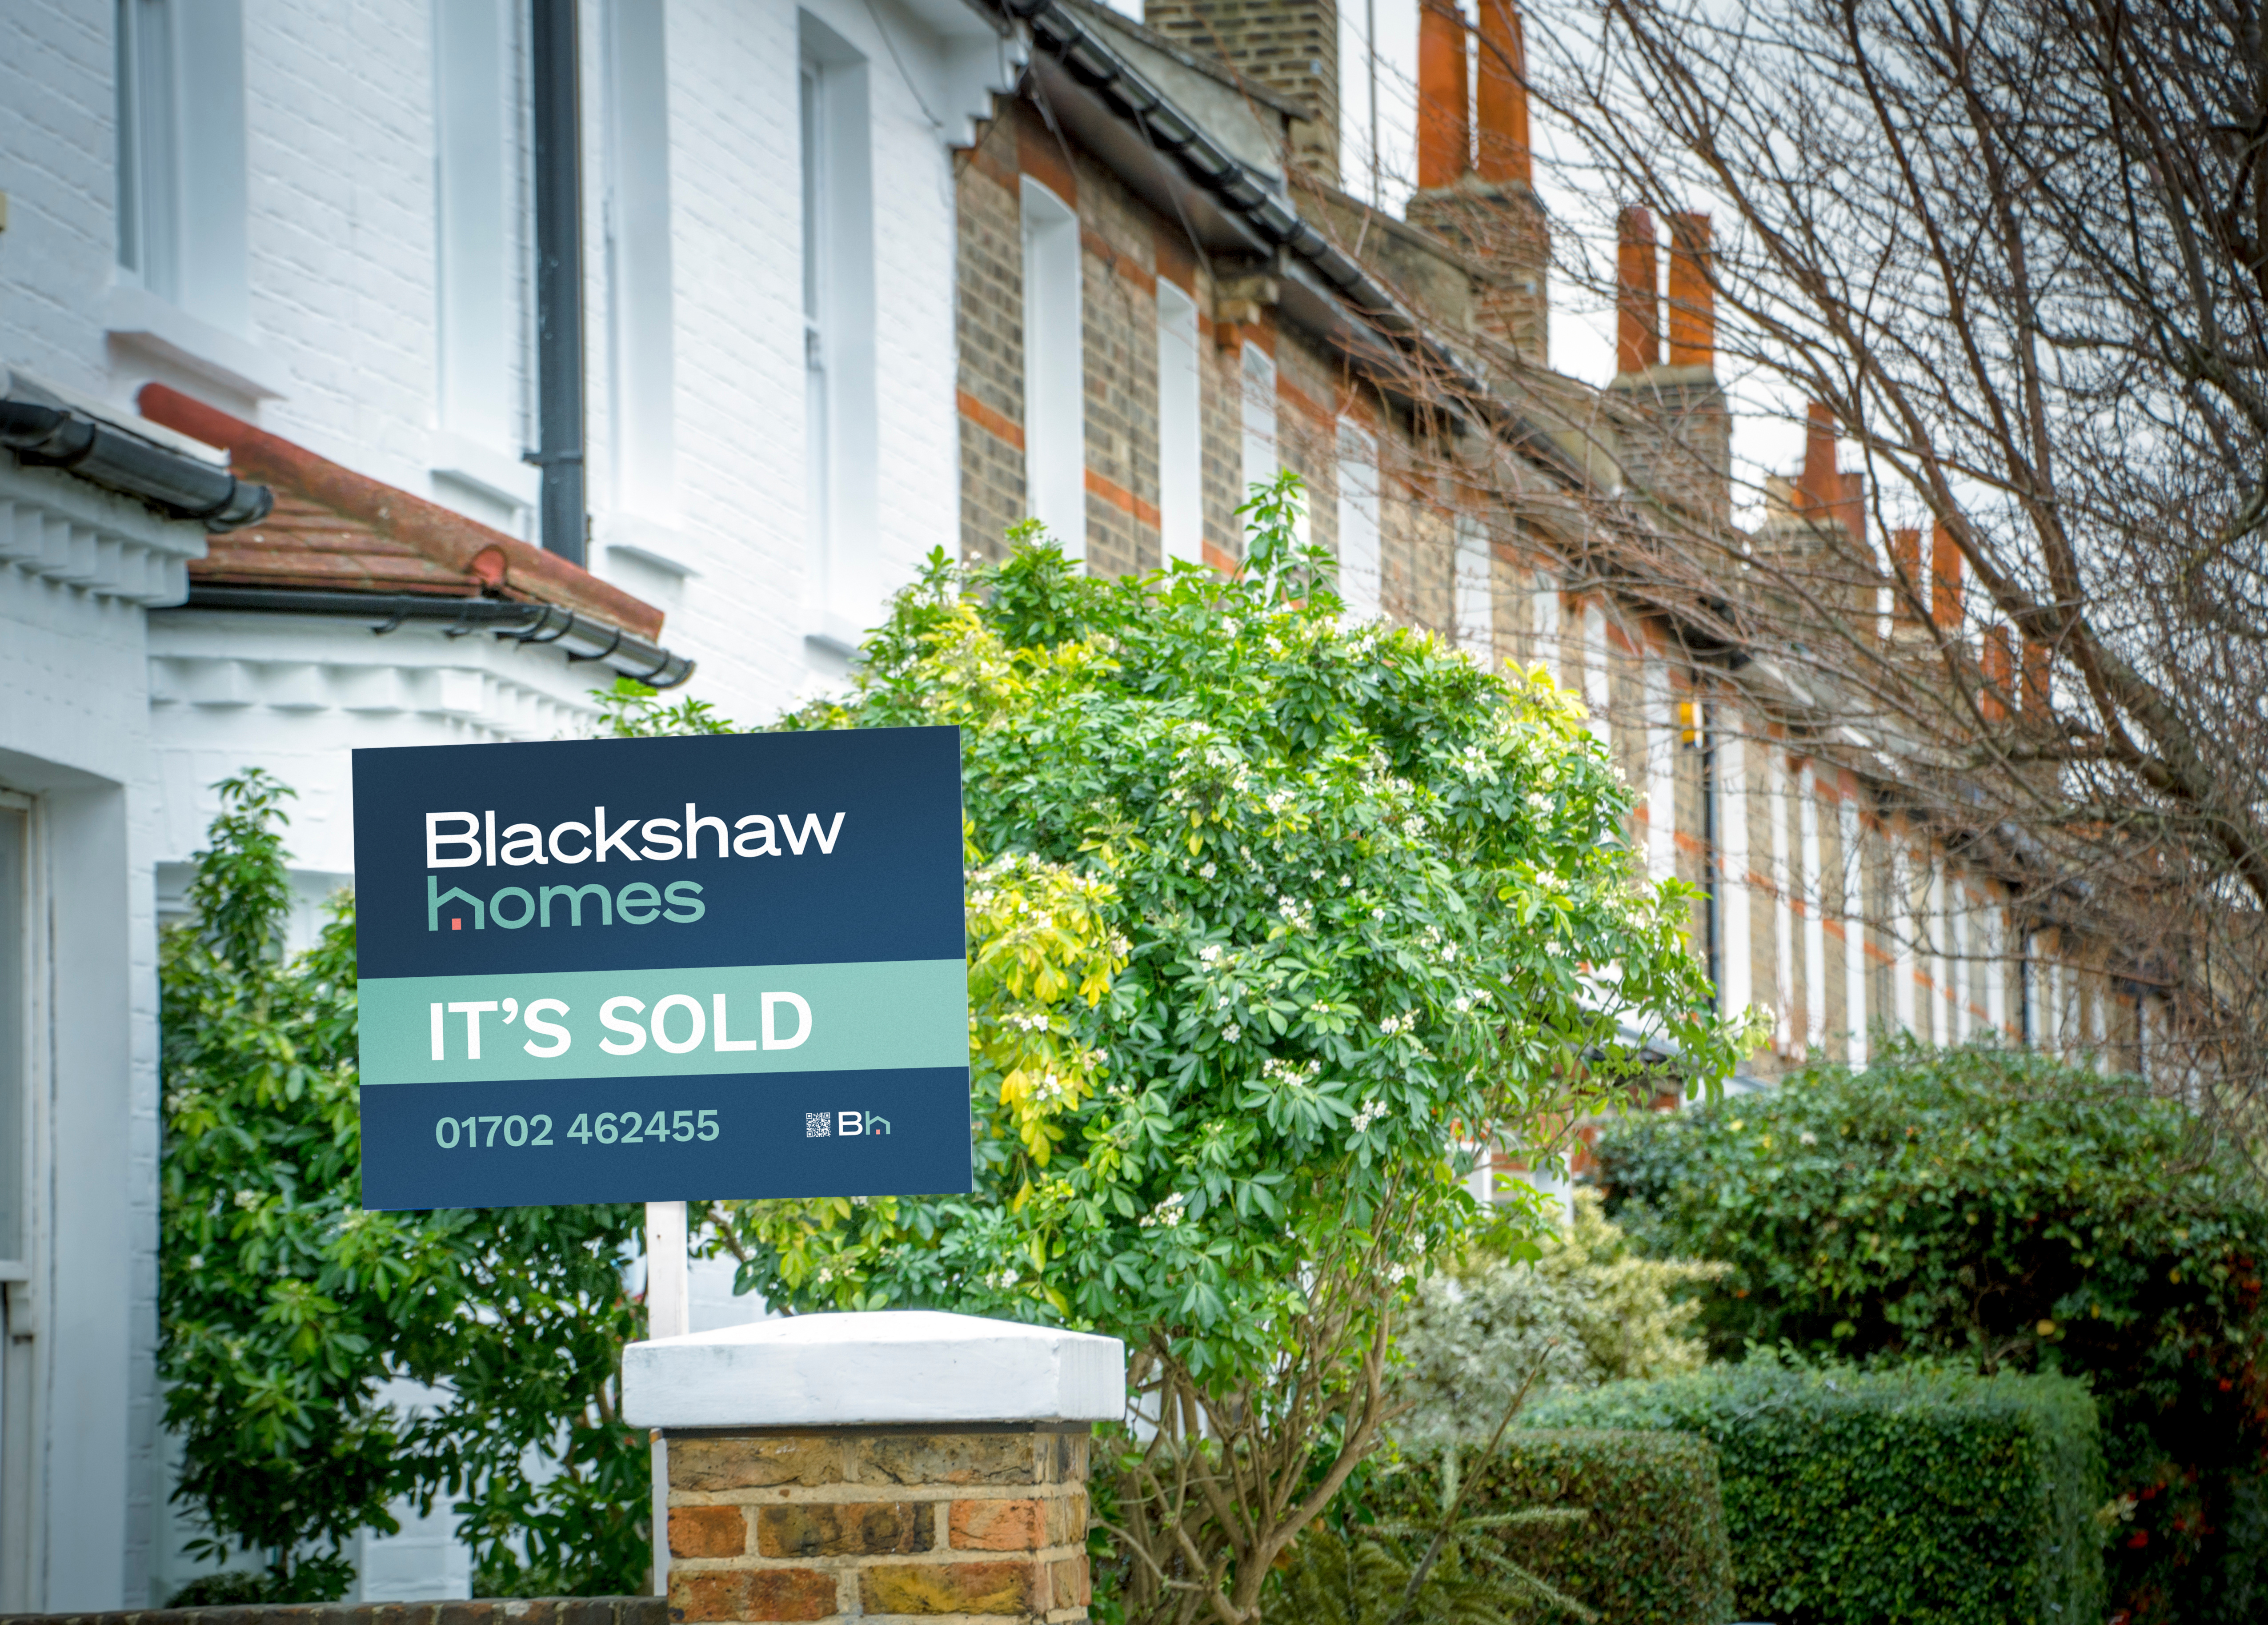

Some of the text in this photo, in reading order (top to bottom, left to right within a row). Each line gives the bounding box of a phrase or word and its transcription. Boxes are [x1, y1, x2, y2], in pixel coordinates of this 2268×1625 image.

[426, 803, 845, 868] Blackshaw
[428, 875, 705, 931] homes
[430, 991, 813, 1060] IT’S SOLD
[436, 1109, 720, 1149] 01702 462455
[838, 1111, 891, 1136] Bh
